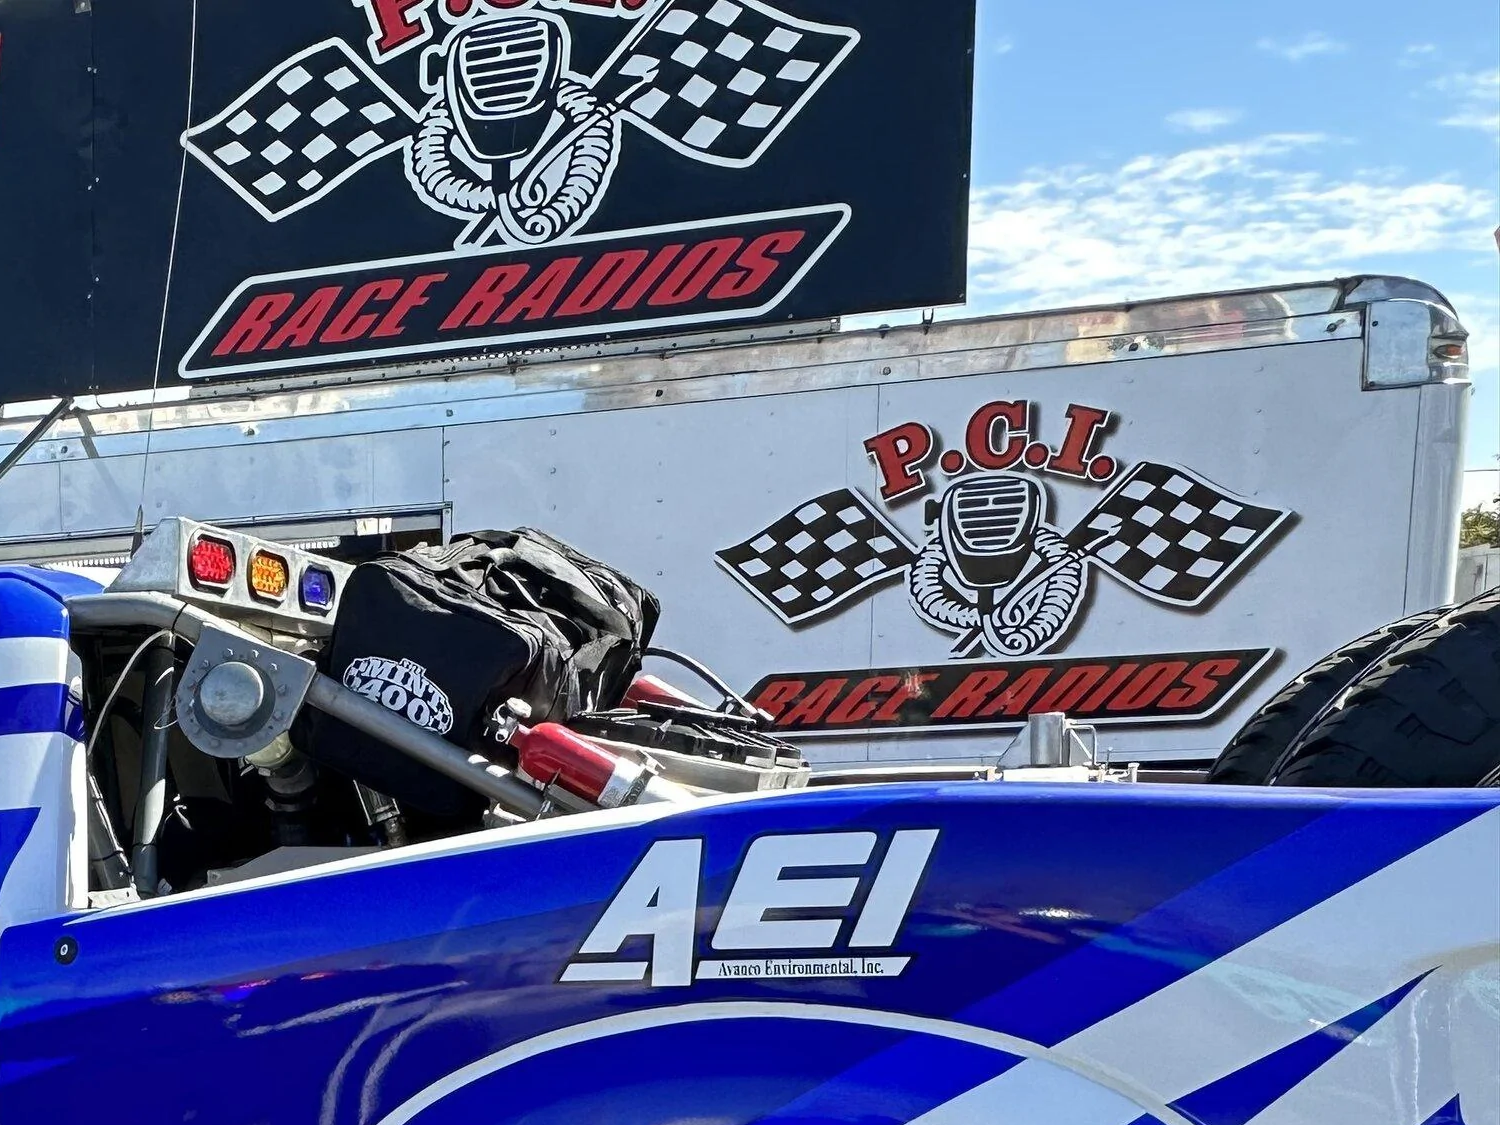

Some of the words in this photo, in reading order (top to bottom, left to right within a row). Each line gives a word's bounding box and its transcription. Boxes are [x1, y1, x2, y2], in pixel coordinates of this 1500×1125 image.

[212, 272, 448, 357] RACE
[440, 230, 805, 331] RADIOS
[863, 400, 1118, 501] P.C.I.
[359, 678, 430, 727] 400
[360, 657, 442, 713] MINT
[932, 657, 1241, 719] RADIOS
[560, 829, 940, 987] AEI
[861, 958, 884, 974] Inc.
